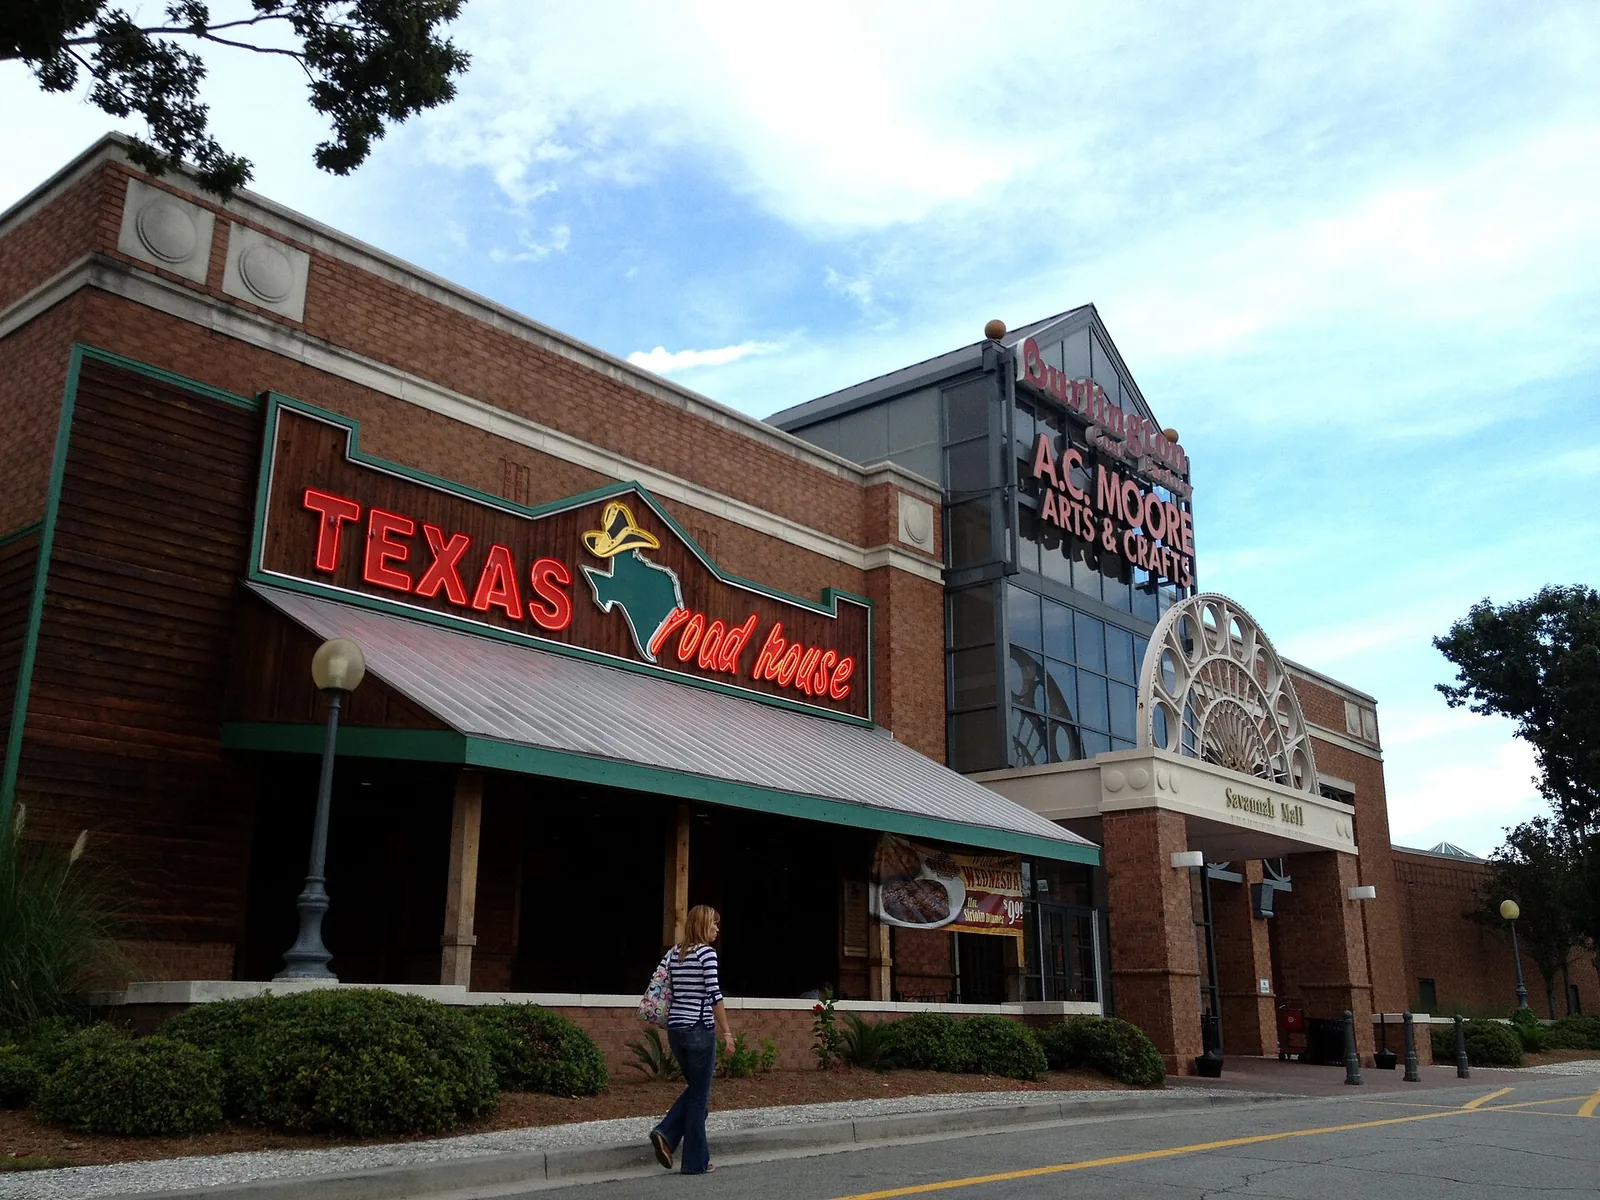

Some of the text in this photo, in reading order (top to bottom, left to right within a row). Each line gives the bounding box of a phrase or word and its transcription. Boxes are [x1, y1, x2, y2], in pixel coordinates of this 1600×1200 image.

[1017, 337, 1189, 475] Burlington
[1033, 432, 1194, 556] A.C. MOORE
[1041, 488, 1193, 588] ARTS & CRAFTS
[302, 487, 574, 632] TEXAS
[650, 606, 854, 701] road house
[1225, 787, 1304, 827] Savannah Mall
[961, 865, 1023, 891] WEDNESDA
[963, 908, 985, 922] Sirloin
